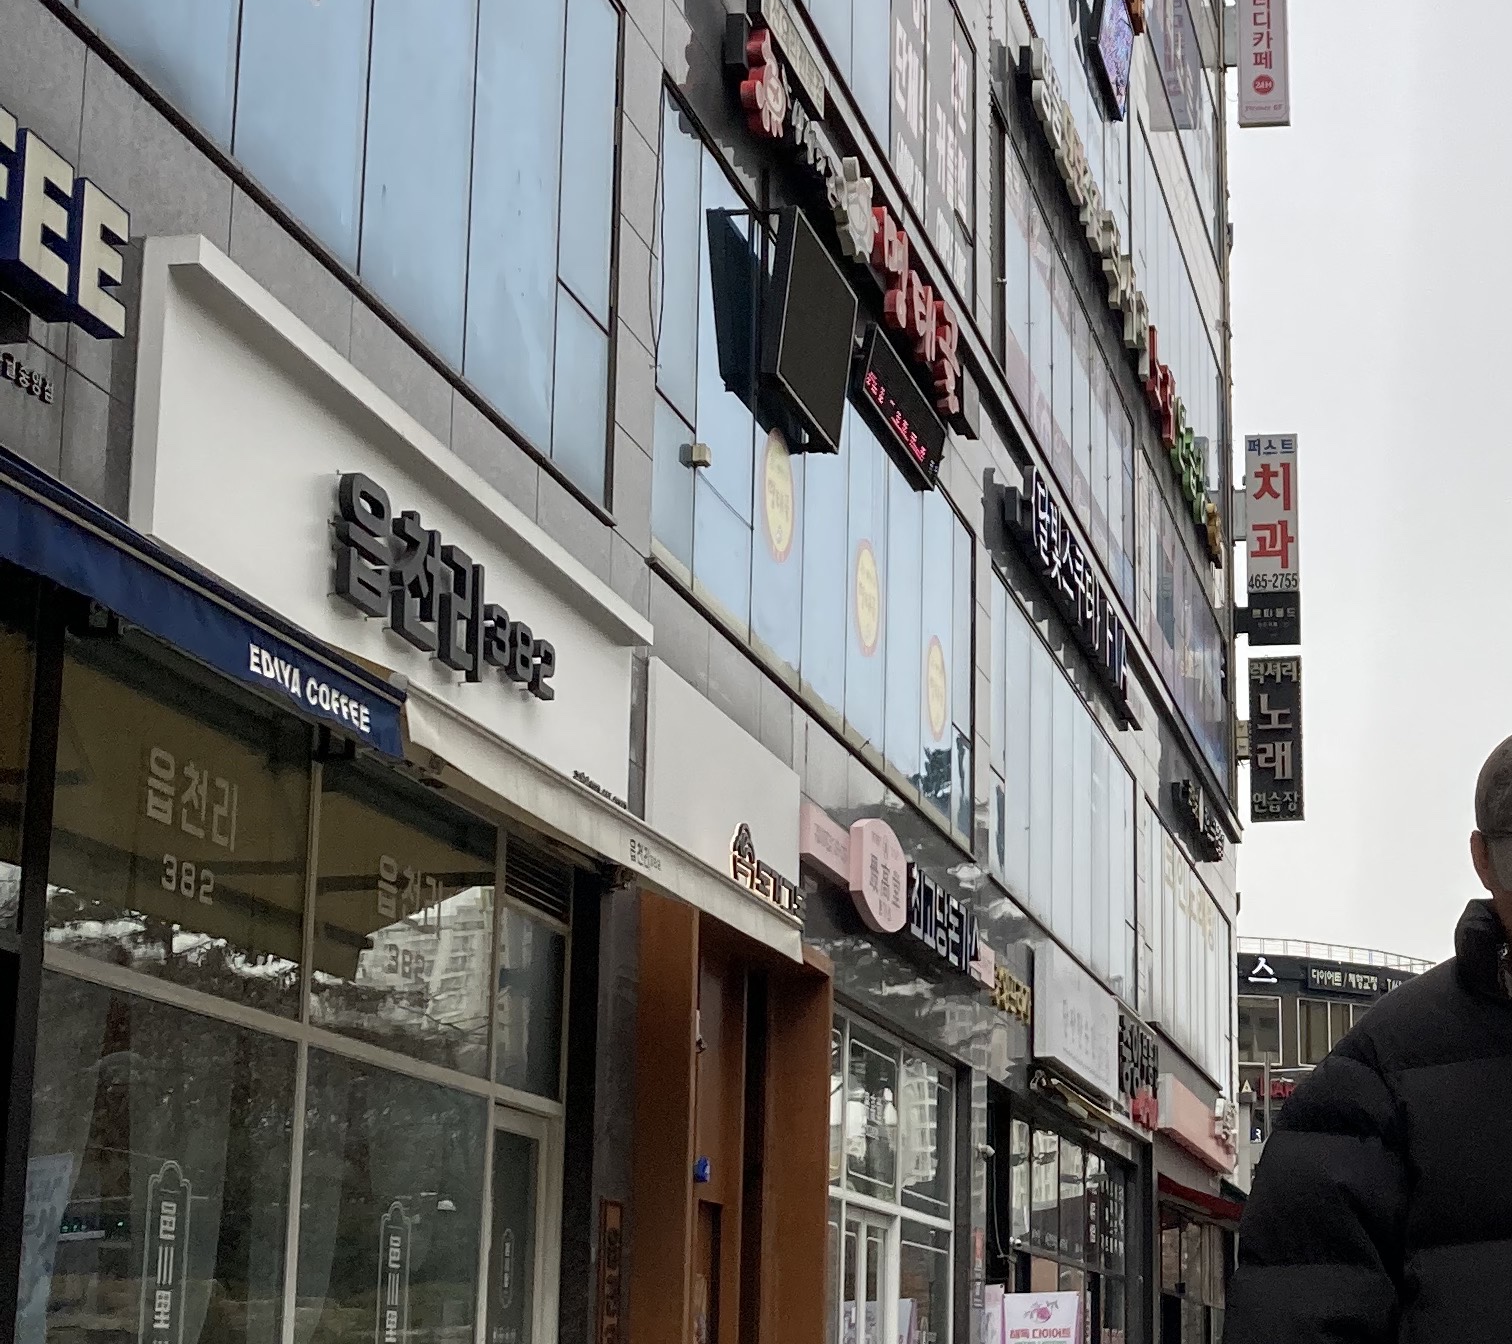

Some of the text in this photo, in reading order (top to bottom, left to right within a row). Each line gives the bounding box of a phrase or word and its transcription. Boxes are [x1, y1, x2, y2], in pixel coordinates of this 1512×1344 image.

[1247, 438, 1296, 457] 퍼스트
[1251, 461, 1295, 570] 치과
[334, 471, 556, 702] 읍천리 382
[1249, 572, 1299, 590] 465-2755
[249, 642, 372, 735] EDIYA COFFEE
[1250, 661, 1298, 685] 럭셔리
[1256, 692, 1294, 781] 노래
[146, 746, 238, 853] 읍천리
[1252, 791, 1299, 815] 연습장
[160, 853, 215, 906] 382
